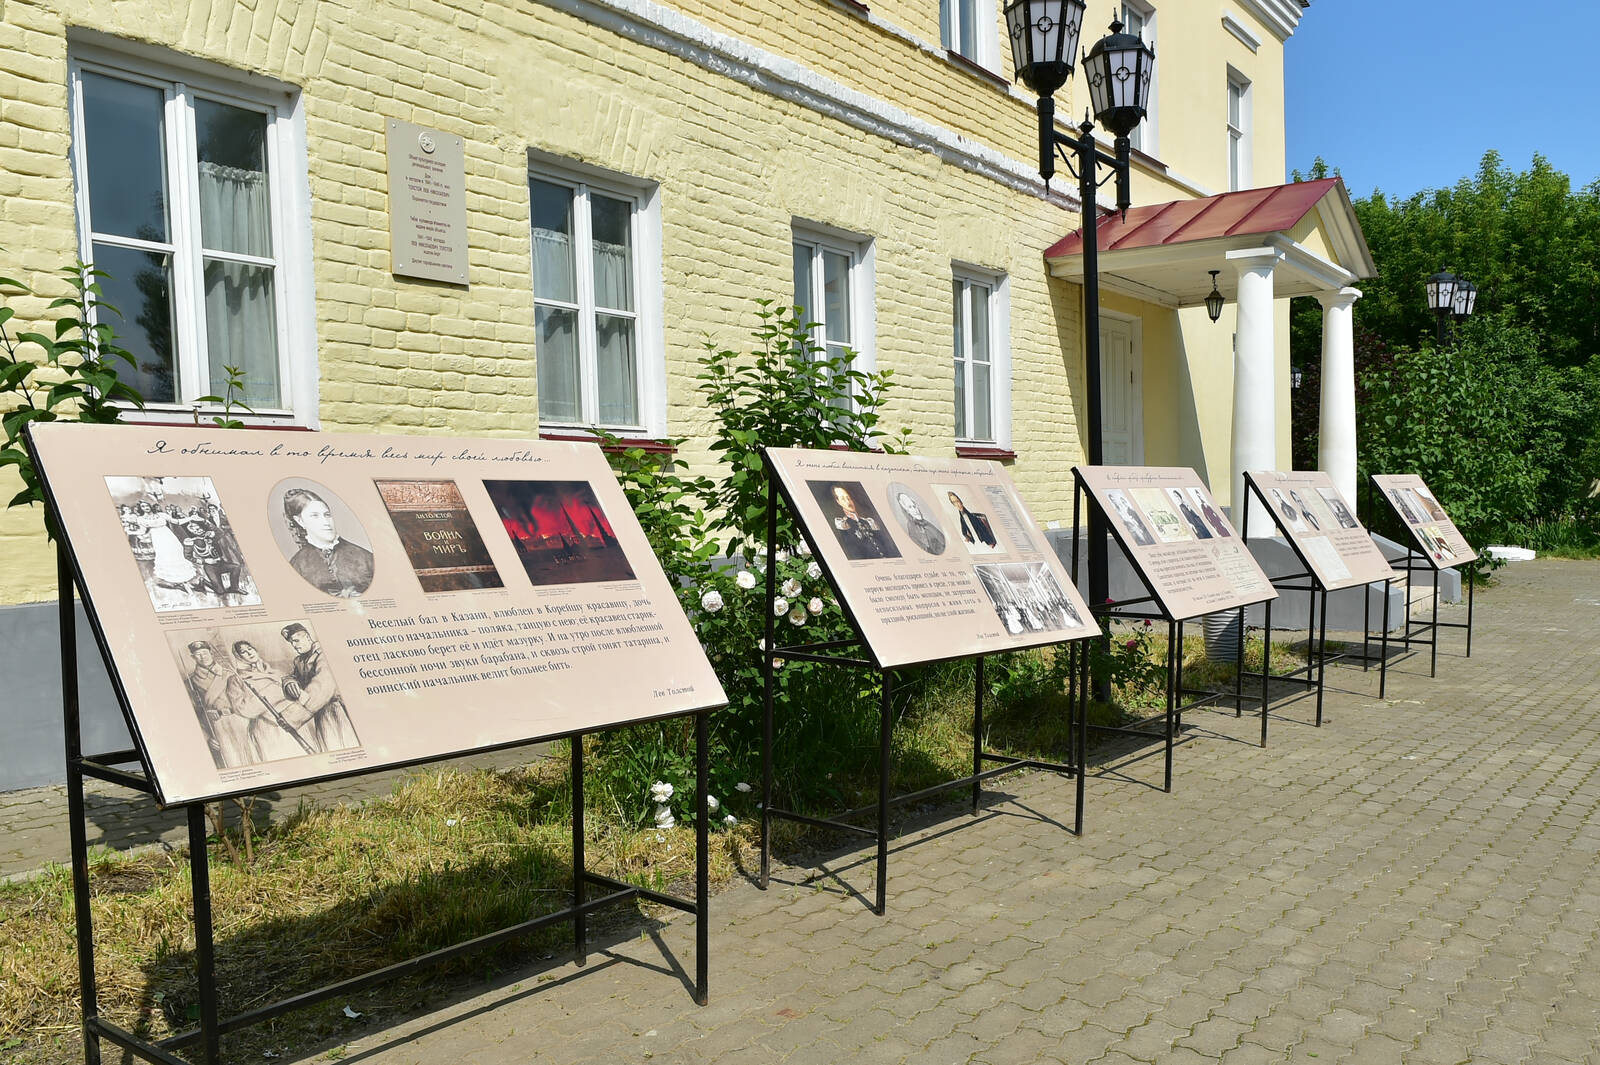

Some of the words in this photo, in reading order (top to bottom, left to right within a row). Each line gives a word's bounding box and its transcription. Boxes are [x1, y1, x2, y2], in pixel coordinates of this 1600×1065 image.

[147, 440, 175, 454] Я
[181, 442, 264, 456] обнимал
[270, 443, 284, 456] в
[317, 444, 377, 465] время
[381, 446, 409, 459] весь
[414, 450, 446, 466] мир
[451, 449, 487, 461] своей
[423, 530, 463, 541] ВОЙНА
[432, 544, 467, 554] МИРЪ
[368, 616, 415, 629] Веселый
[418, 614, 439, 625] бал
[451, 611, 492, 622] Казани,
[493, 605, 534, 618] влюблен
[536, 607, 543, 615] в
[586, 600, 632, 612] красавицу,
[346, 635, 405, 648] воинского
[405, 627, 470, 643] начальника
[478, 623, 518, 635] поляка,
[518, 619, 551, 632] танцую
[579, 615, 588, 624] её
[588, 613, 628, 625] красавец
[353, 653, 381, 664] отец
[383, 646, 427, 660] ласково
[427, 644, 457, 657] берет
[459, 641, 472, 651] её
[472, 642, 481, 650] и
[481, 638, 505, 650] идёт
[506, 635, 547, 649] мазурку.
[549, 632, 556, 642] И
[557, 632, 569, 641] на
[570, 630, 590, 643] утро
[591, 627, 615, 638] после
[616, 622, 664, 636] влюбленной
[359, 664, 418, 680] бессонной
[420, 660, 447, 672] ночи
[449, 656, 480, 670] звуки
[480, 652, 530, 666] барабана,
[531, 649, 538, 658] и
[540, 646, 570, 657] сквозь
[571, 641, 597, 655] строй
[597, 640, 622, 651] гонят
[623, 636, 663, 649] татарина,
[366, 679, 421, 695] воинский
[422, 674, 480, 688] начальник
[480, 669, 509, 681] велит
[509, 663, 548, 677] больнее
[548, 661, 573, 672] бить.
